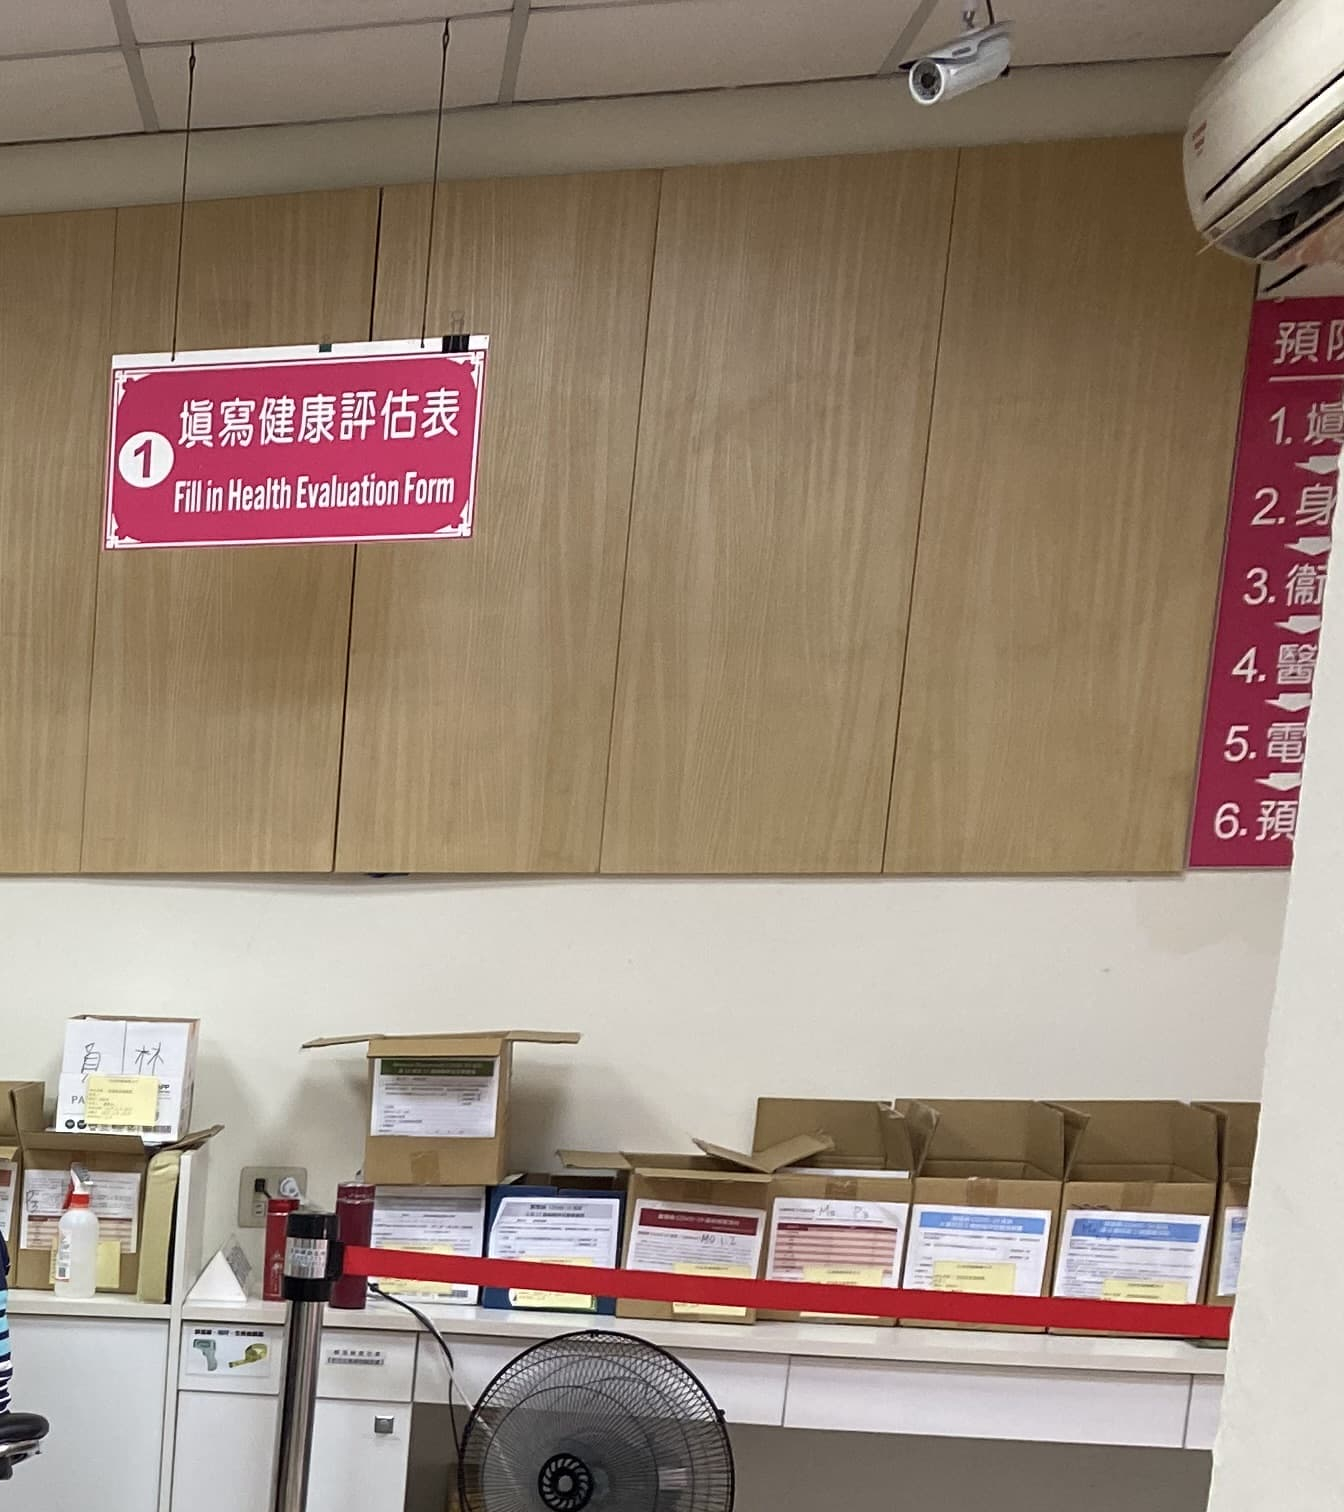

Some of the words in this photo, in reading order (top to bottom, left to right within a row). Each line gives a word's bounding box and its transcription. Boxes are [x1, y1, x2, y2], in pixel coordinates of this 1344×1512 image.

[133, 439, 153, 479] 1
[174, 479, 201, 513] Fill
[206, 479, 223, 512] in
[227, 475, 291, 512] Health
[295, 472, 401, 509] Evaluation
[403, 471, 455, 505] Form
